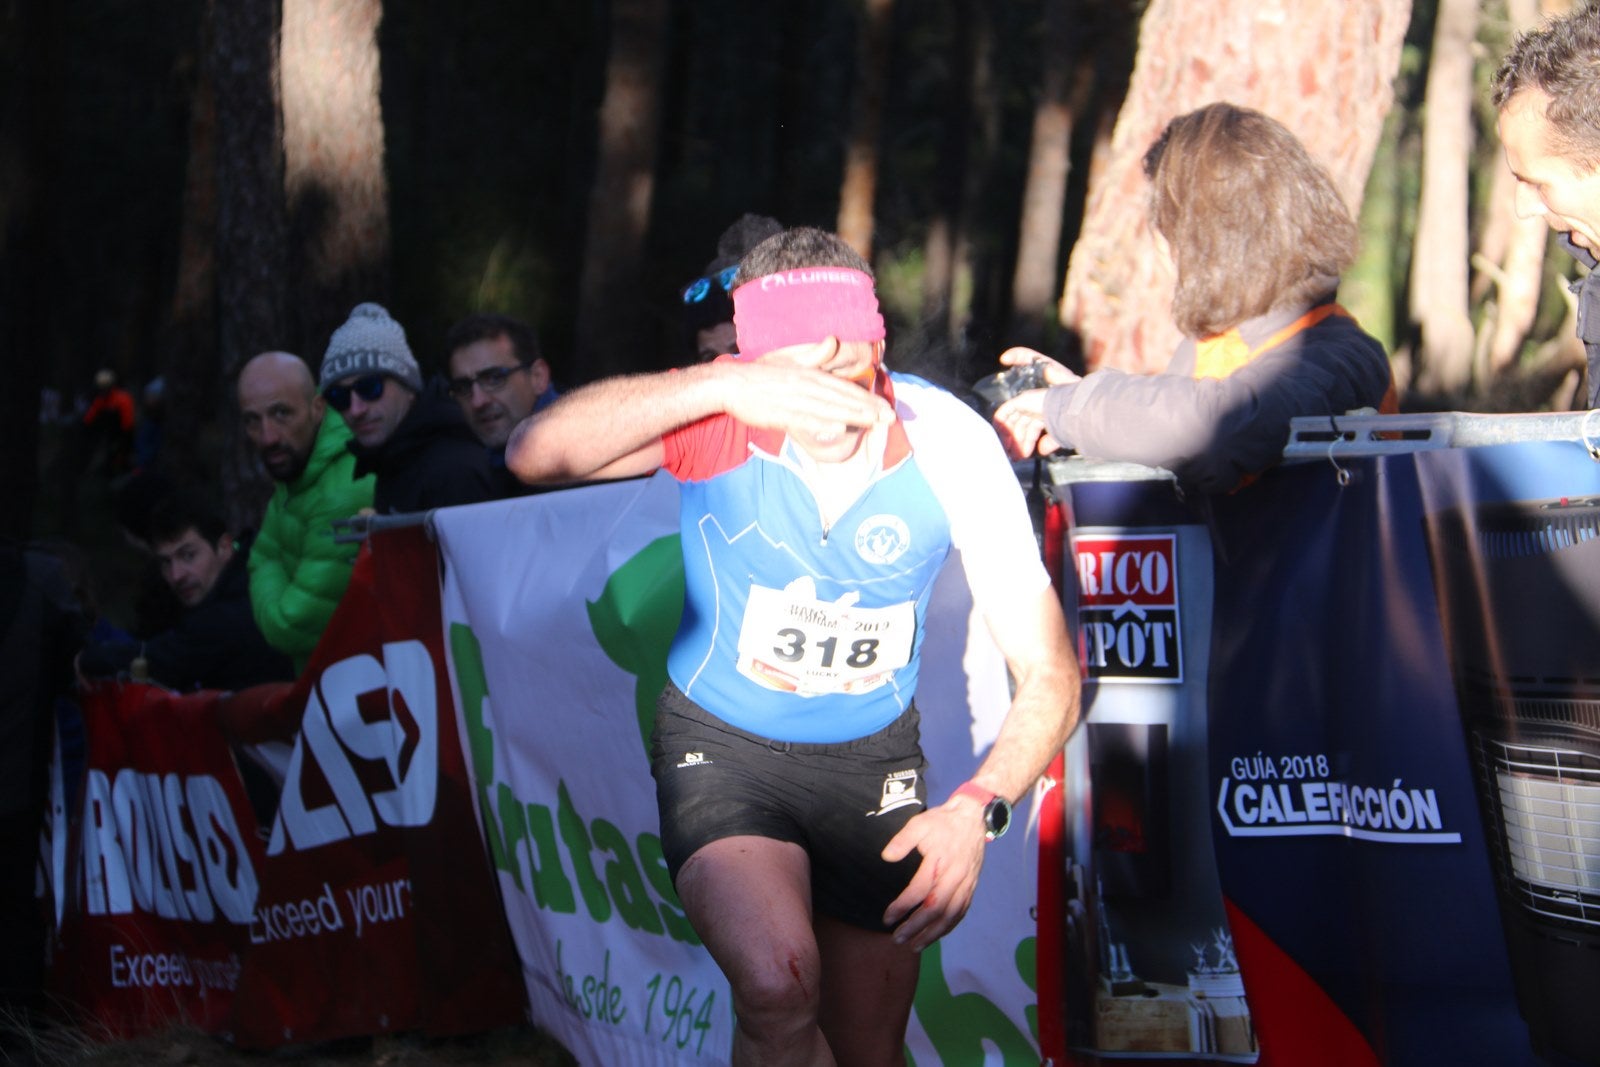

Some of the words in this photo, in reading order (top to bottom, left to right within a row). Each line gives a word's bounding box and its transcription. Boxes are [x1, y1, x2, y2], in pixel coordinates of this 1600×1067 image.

[773, 628, 880, 669] 318
[1231, 750, 1278, 780] GUÍA
[1281, 754, 1330, 779] 2018
[1234, 778, 1442, 830] CALEFACCIÓN
[645, 973, 716, 1057] 1964
